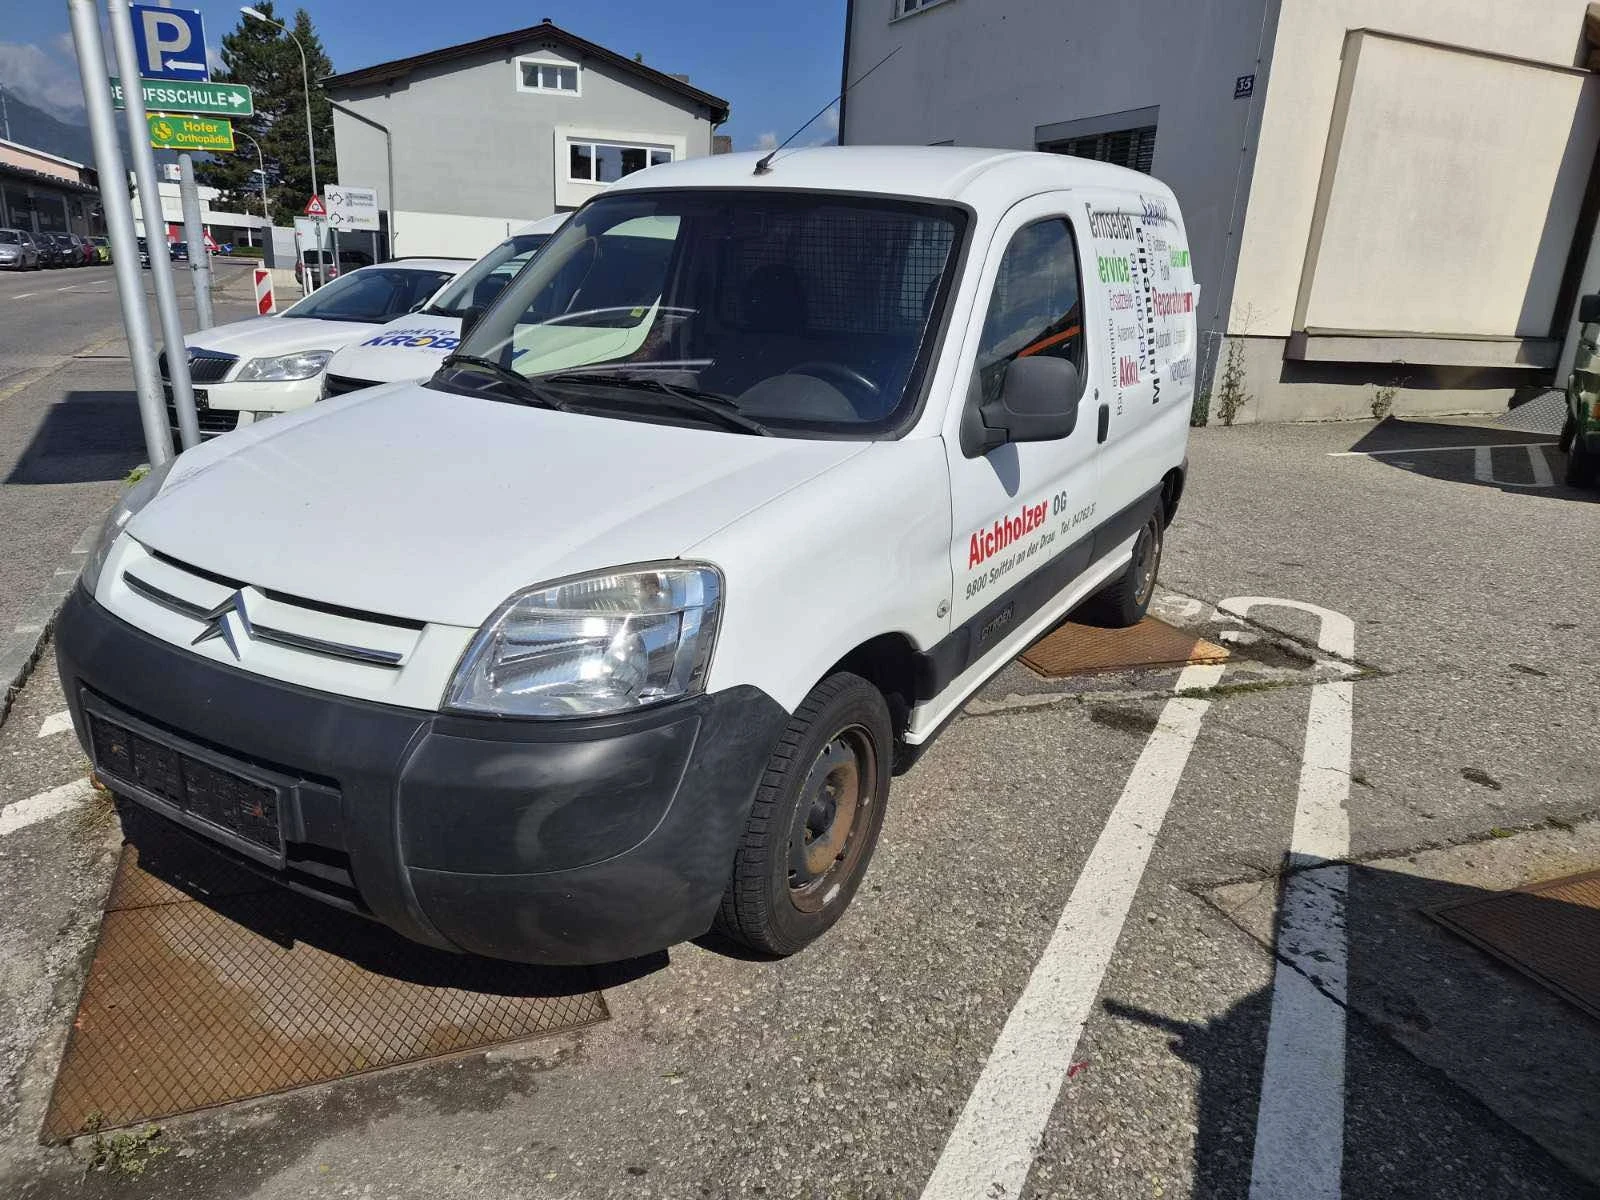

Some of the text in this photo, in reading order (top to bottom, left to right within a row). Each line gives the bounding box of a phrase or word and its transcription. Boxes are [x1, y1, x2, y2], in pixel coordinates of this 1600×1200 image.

[142, 11, 192, 72] P
[109, 86, 228, 106] BEFSSCHULE
[176, 133, 230, 144] Orthopädie
[184, 121, 219, 132] Hofer
[1096, 247, 1131, 283] ervice
[1136, 228, 1160, 405] Multimedia
[968, 490, 1067, 571] Aichholzer OG
[966, 573, 988, 600] 9800
[989, 554, 1016, 585] Spittal
[1016, 550, 1026, 566] an
[1026, 542, 1040, 559] der
[1040, 532, 1056, 550] Drau
